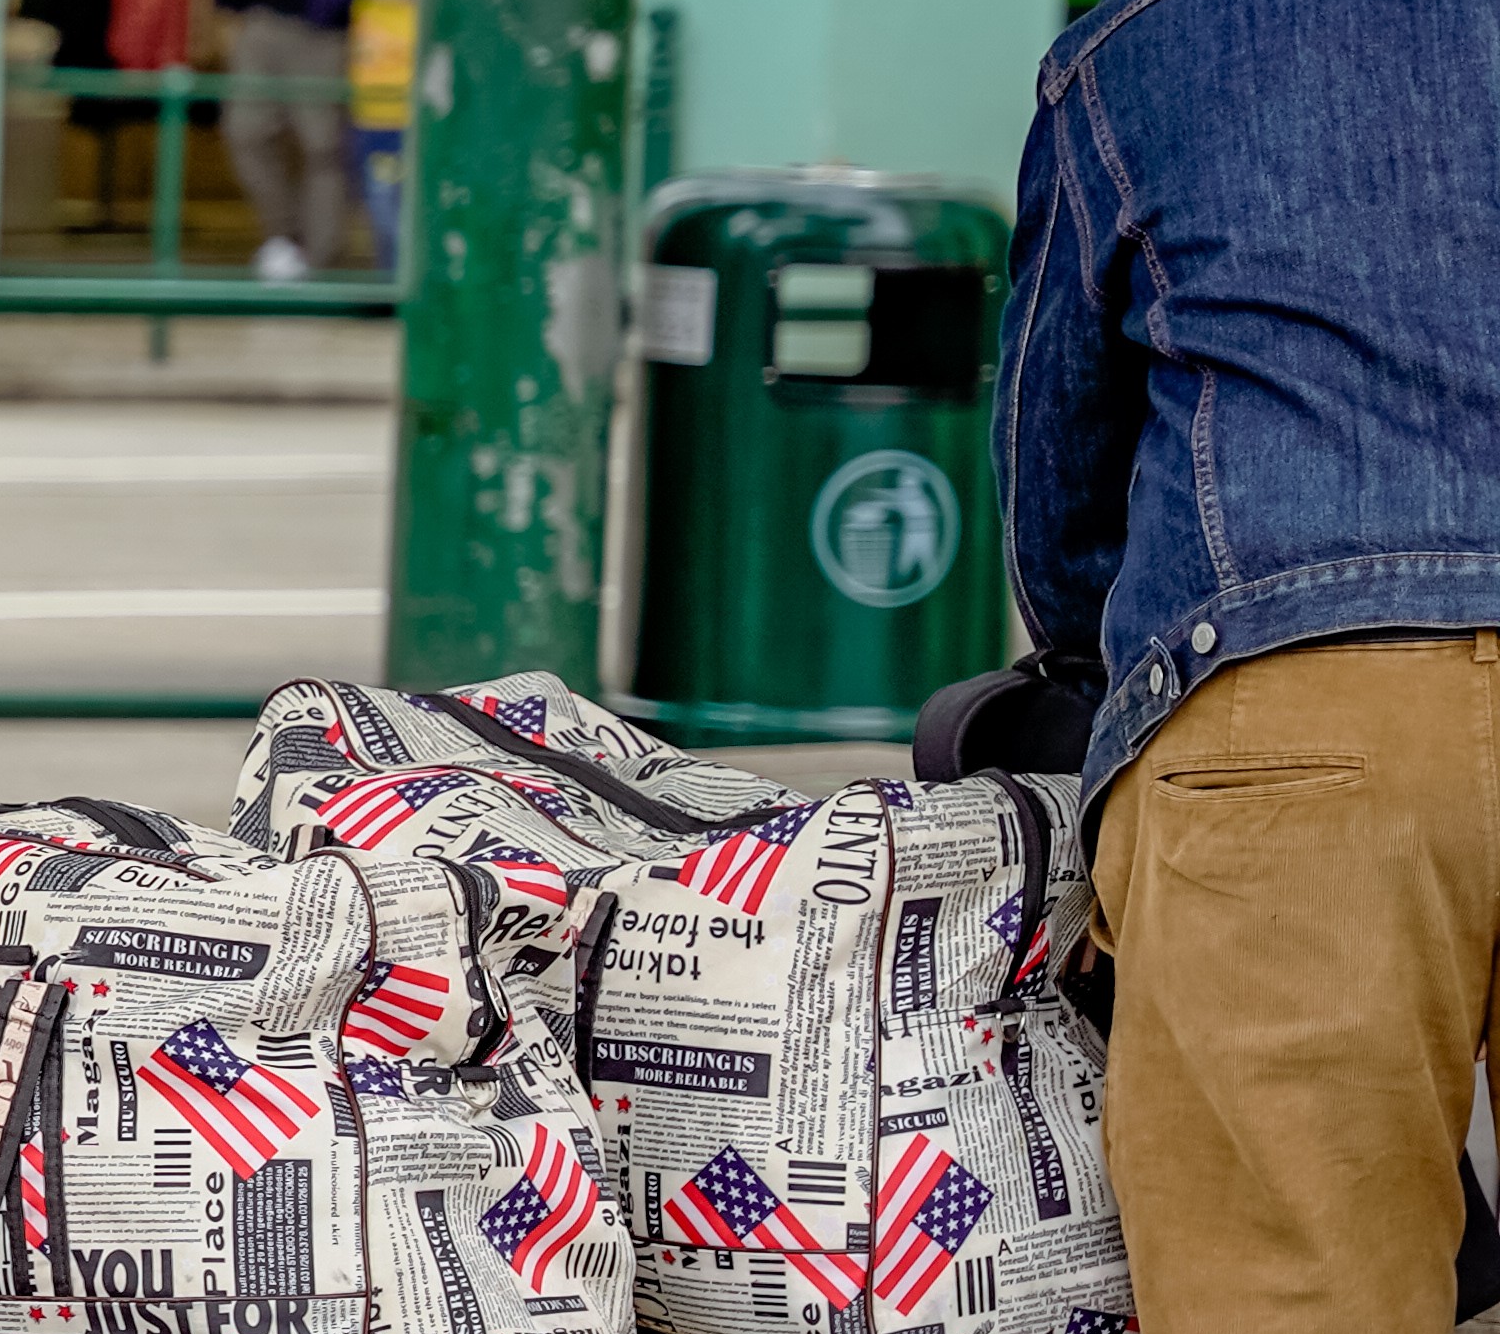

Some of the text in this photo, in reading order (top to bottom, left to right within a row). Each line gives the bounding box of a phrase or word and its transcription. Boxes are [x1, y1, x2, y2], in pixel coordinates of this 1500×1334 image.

[83, 930, 227, 959] SUBSCRIBING
[709, 917, 765, 949] the
[113, 952, 243, 979] MORE RELIABLE
[918, 916, 933, 990] RELIABLE
[597, 1042, 755, 1073] SUBSCRIBING IS
[634, 1067, 748, 1091] MORE RELIABLE
[888, 1111, 946, 1129] SICURO
[648, 1175, 660, 1234] SICURO
[72, 1249, 175, 1298] YOU
